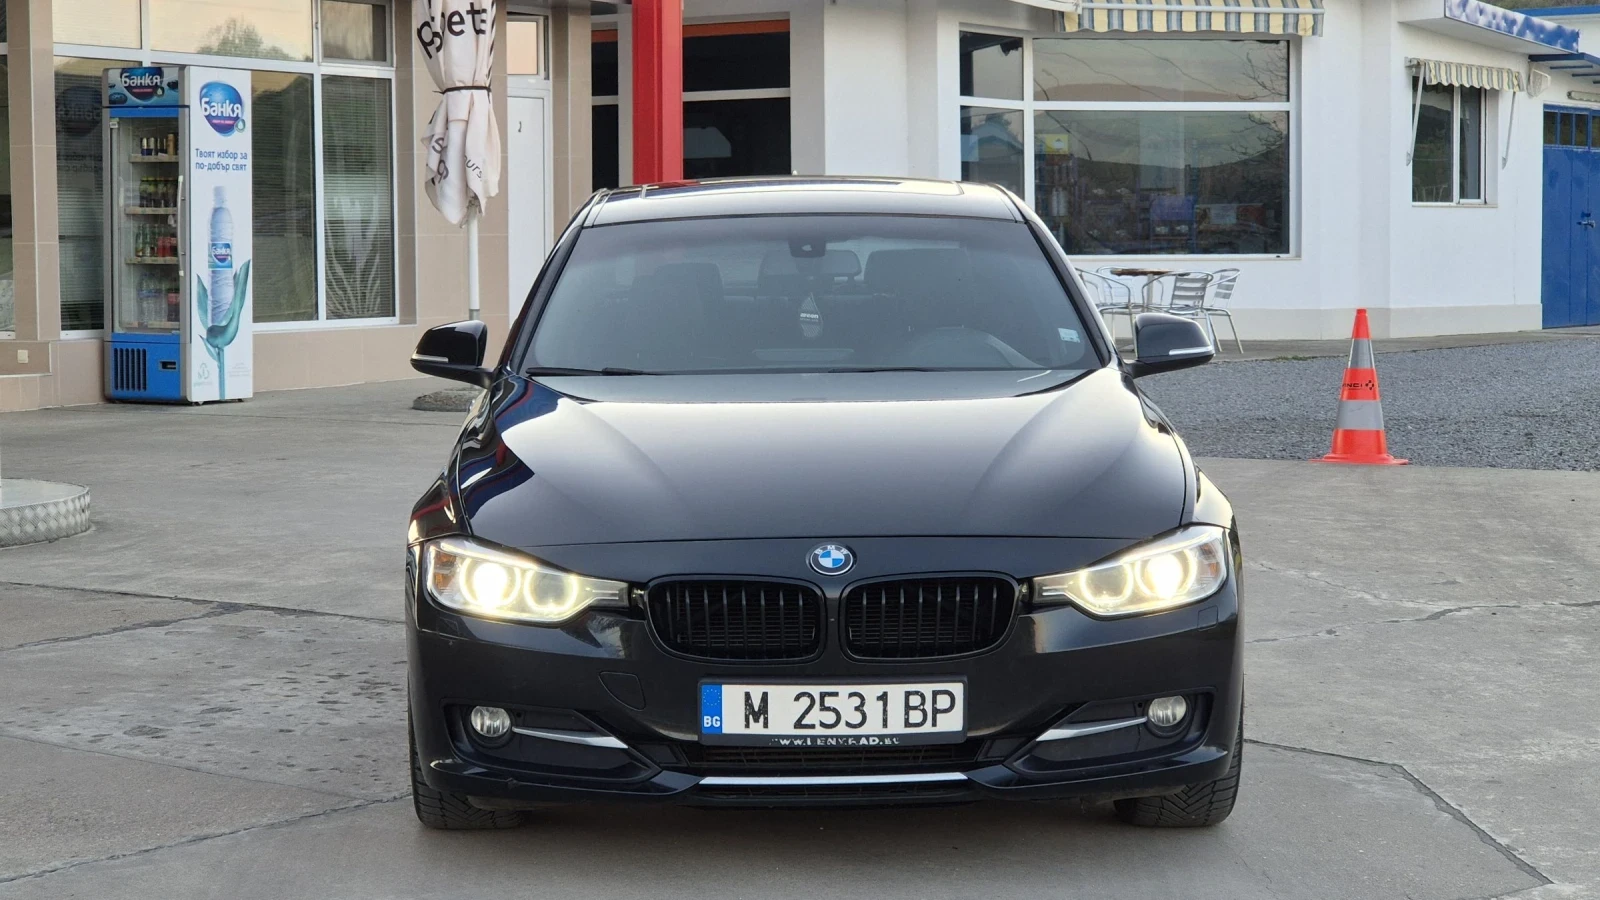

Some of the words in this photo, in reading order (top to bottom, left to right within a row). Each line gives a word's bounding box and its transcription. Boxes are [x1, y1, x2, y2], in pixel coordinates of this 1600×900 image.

[195, 148, 215, 158] Твоят
[217, 150, 239, 161] избор
[240, 152, 248, 160] за
[195, 161, 230, 172] по-добър
[231, 163, 247, 171] свят
[813, 544, 850, 555] BMW
[744, 691, 769, 729] M
[793, 691, 889, 729] 2531
[903, 689, 956, 729] BP
[703, 716, 721, 728] BG
